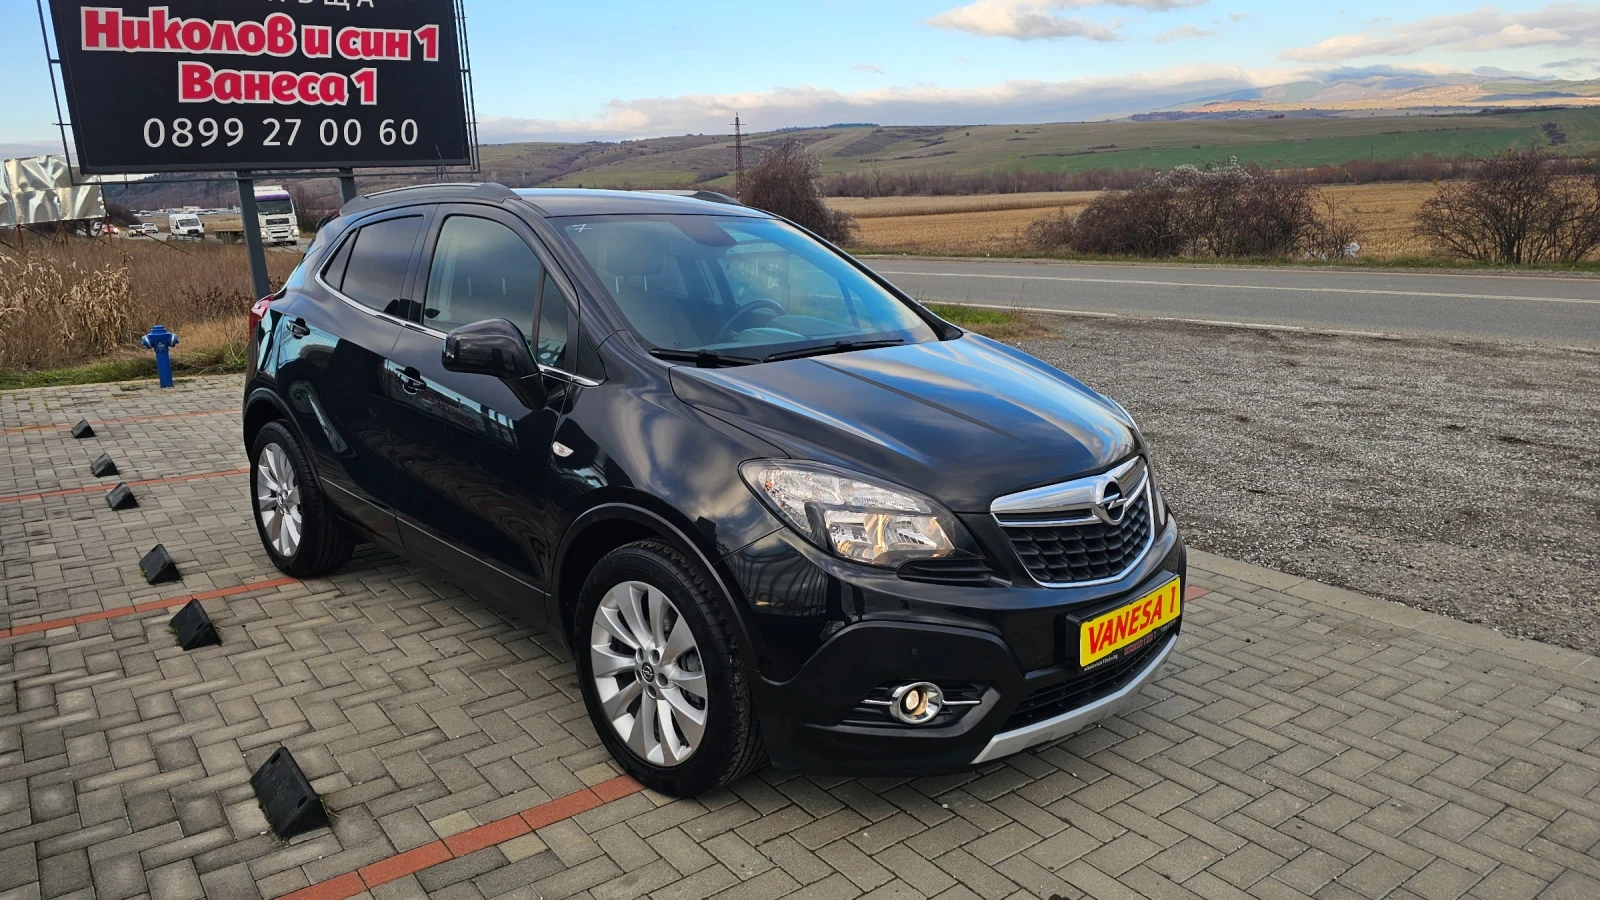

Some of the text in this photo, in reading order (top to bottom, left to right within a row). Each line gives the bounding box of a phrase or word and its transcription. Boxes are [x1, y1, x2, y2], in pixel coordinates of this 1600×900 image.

[81, 7, 440, 62] Николов и син 1
[178, 61, 378, 106] Ванеса 1
[143, 117, 419, 148] 0899 27 00 60
[1088, 594, 1163, 655] VANESA
